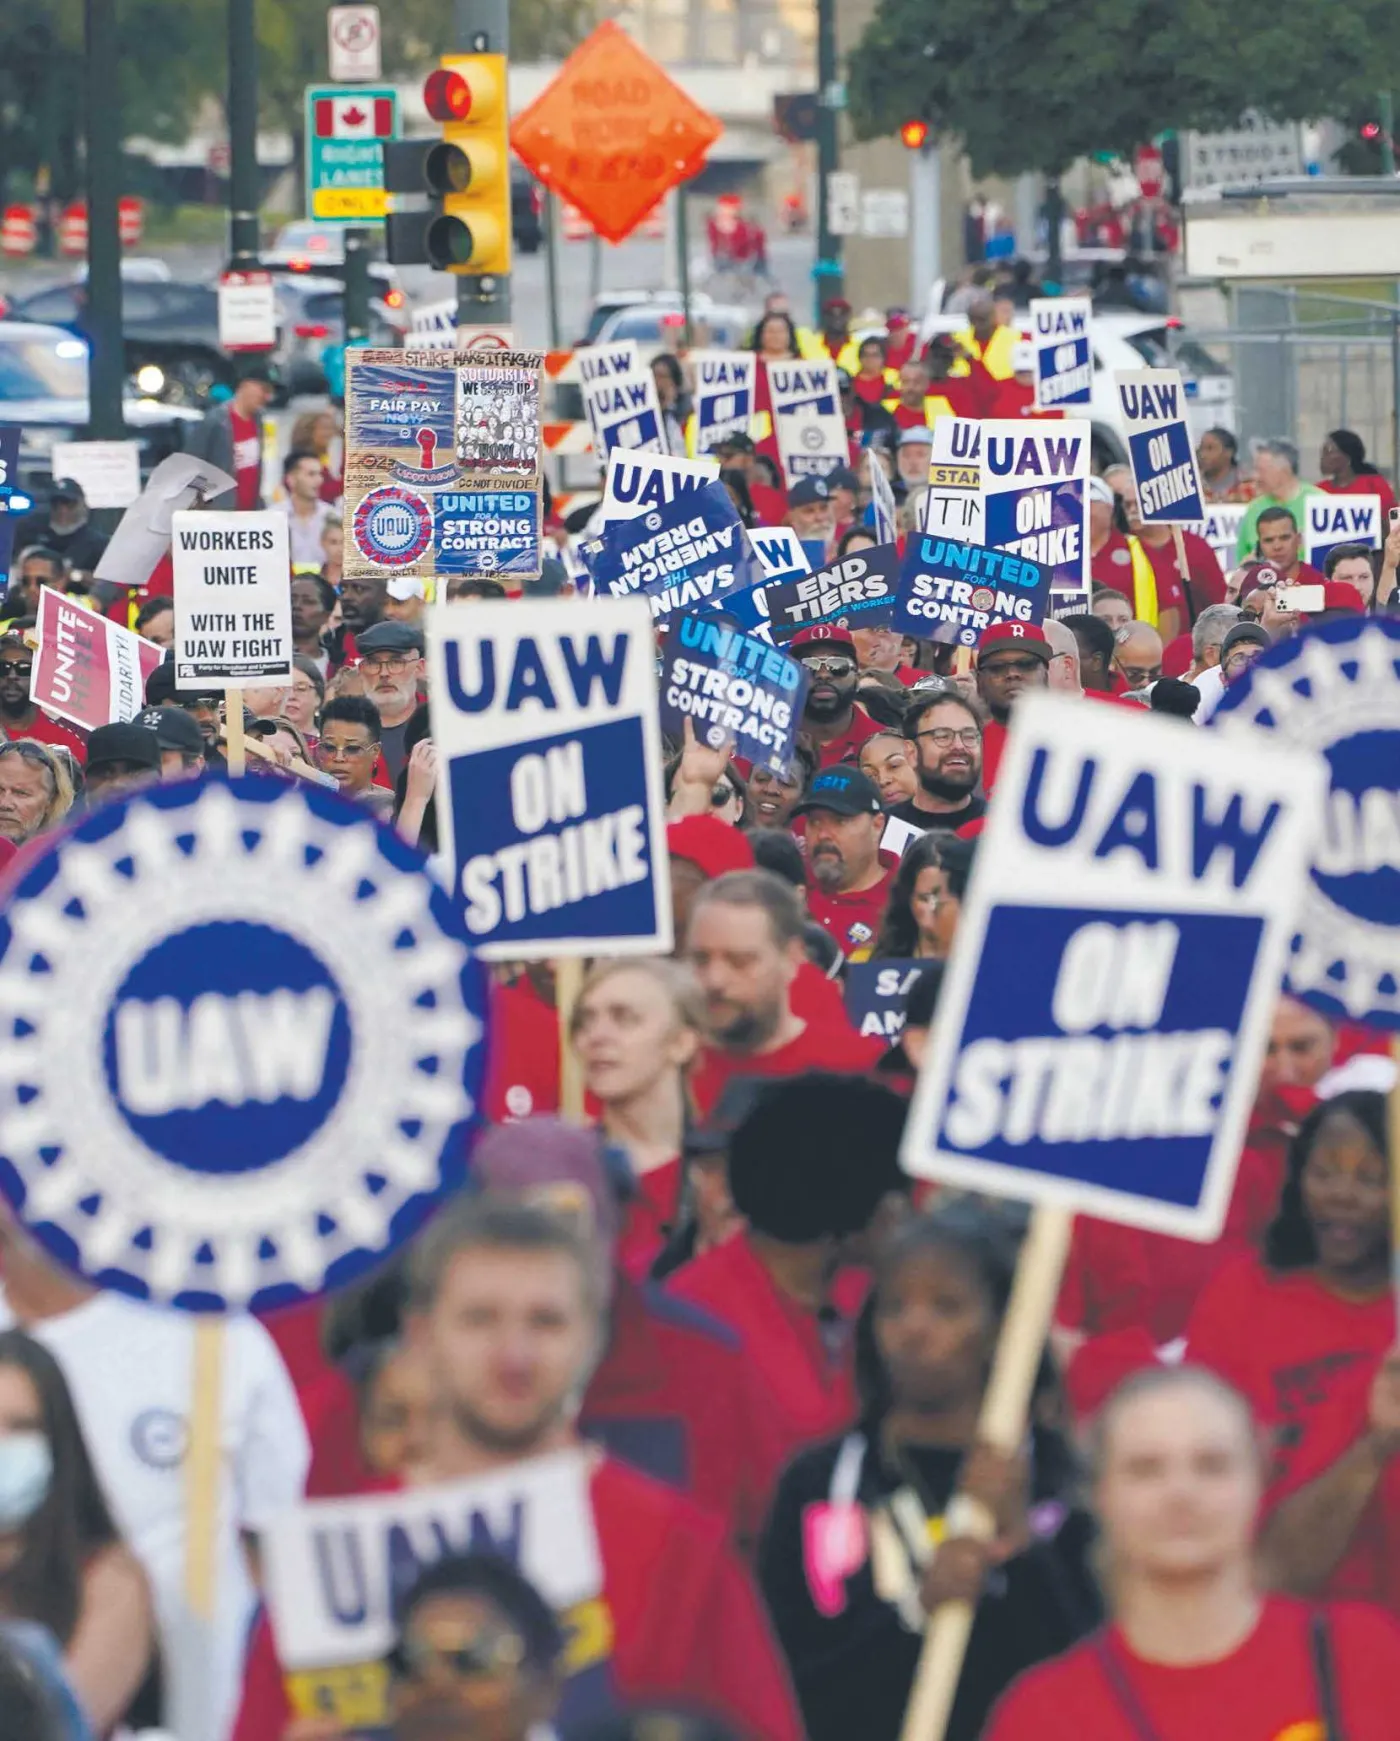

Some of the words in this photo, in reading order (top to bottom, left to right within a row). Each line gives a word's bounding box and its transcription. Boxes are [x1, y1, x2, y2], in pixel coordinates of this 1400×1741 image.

[1036, 311, 1086, 334] UAW
[580, 352, 631, 381] UAW
[702, 361, 748, 384] UAW
[773, 368, 829, 393] UAW
[370, 399, 408, 412] FAIR
[411, 401, 441, 413] PAY
[463, 382, 478, 395] WE
[594, 383, 647, 414] UAW
[1120, 384, 1178, 420] UAW
[951, 423, 981, 459] UA
[987, 437, 1082, 477] UAW
[1148, 433, 1173, 472] ON
[442, 495, 531, 512] UNITED
[493, 478, 531, 489] DIVIDE
[1140, 462, 1196, 515] STRIKE
[376, 517, 410, 536] UAW
[442, 519, 532, 536] STRONG
[1015, 490, 1053, 535] ON
[1311, 507, 1374, 533] UAW
[180, 530, 274, 551] WORKERS
[440, 536, 533, 550] CONTRACT
[620, 516, 708, 571] DREAM
[993, 524, 1080, 567] TRIKE
[203, 566, 258, 585] UNITE
[608, 526, 734, 599] AMERICAN
[796, 558, 868, 602] END
[920, 538, 1040, 588] UNITED
[962, 573, 988, 587] FOR
[989, 579, 997, 588] A
[650, 564, 735, 618] SAVIN
[784, 575, 889, 623] TIERS
[911, 573, 1033, 622] STRNG
[190, 614, 236, 632] WITH
[242, 613, 275, 631] THE
[906, 598, 1003, 630] CONTR
[50, 606, 77, 703] UNITE
[184, 640, 226, 658] UAW
[232, 638, 282, 658] FIGHT
[680, 616, 799, 691] UNITED
[116, 635, 134, 724] OLIDARITY!
[444, 633, 630, 716] UAW
[670, 657, 792, 729] STRONG
[666, 685, 788, 752] CONTRACT
[511, 739, 588, 835] ON
[1021, 745, 1284, 889] UAW
[1318, 786, 1400, 876] UA
[461, 803, 649, 936] STRIKE
[1051, 919, 1182, 1035] ON
[114, 983, 337, 1117] UAW
[943, 1026, 1239, 1152] STRIKE
